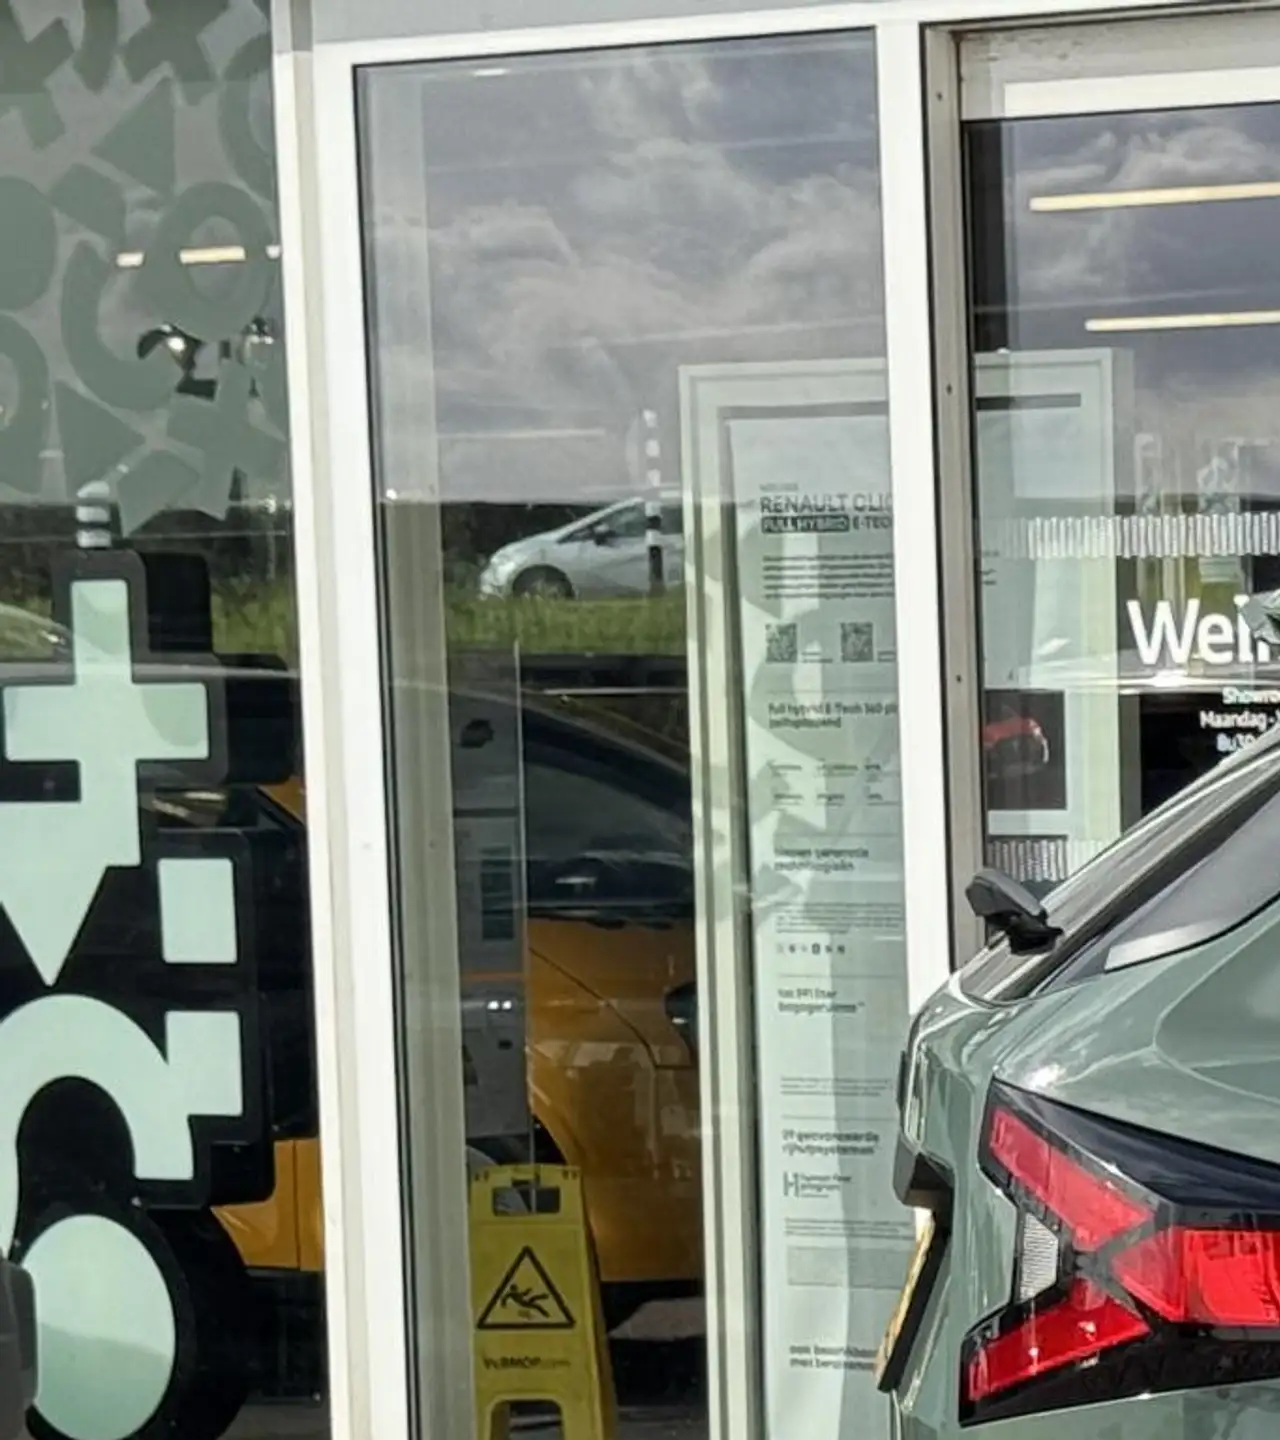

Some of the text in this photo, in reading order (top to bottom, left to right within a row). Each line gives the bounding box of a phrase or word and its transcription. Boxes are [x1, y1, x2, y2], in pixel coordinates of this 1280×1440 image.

[760, 494, 848, 513] RENAULT
[1126, 594, 1271, 665] Wel
[1200, 711, 1266, 730] Maandag
